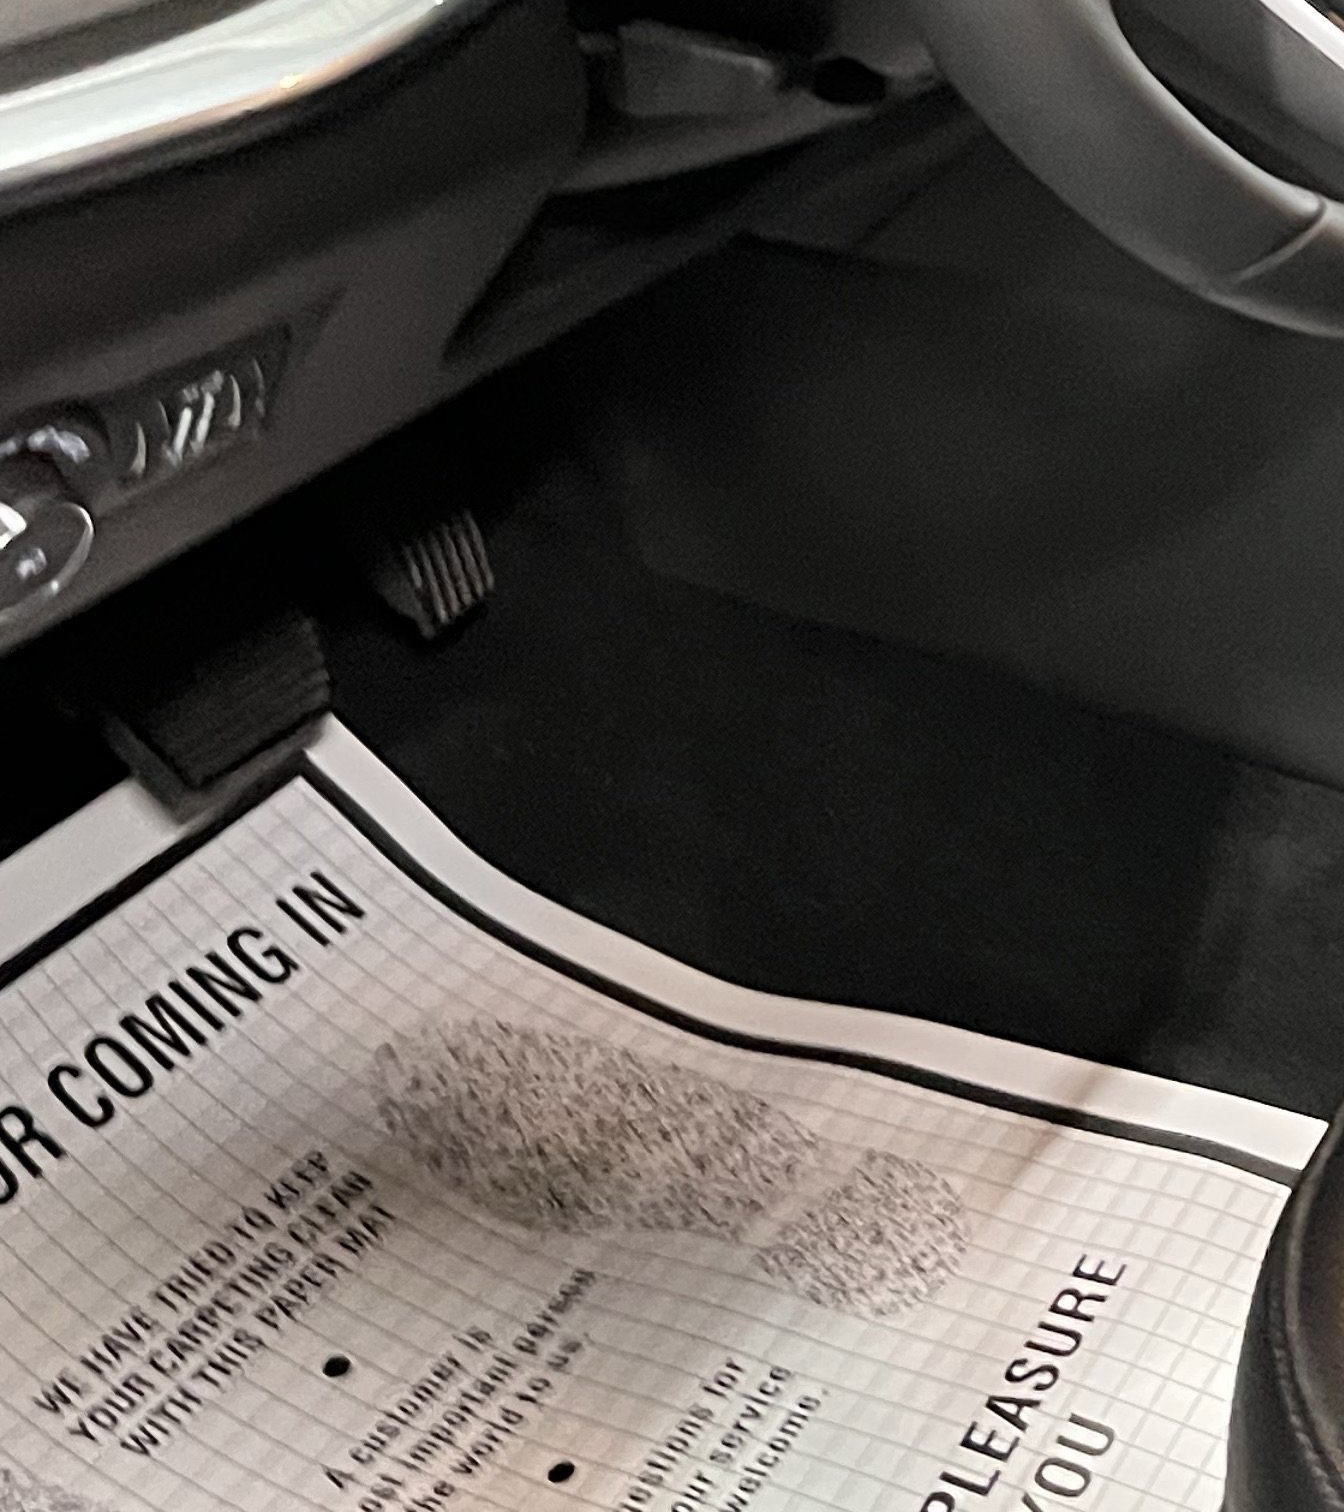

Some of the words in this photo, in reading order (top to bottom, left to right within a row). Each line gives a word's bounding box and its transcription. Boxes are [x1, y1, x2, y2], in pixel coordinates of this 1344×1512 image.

[47, 926, 300, 1128] COMING
[276, 871, 366, 947] IN
[33, 1368, 84, 1414] WE
[80, 1305, 158, 1376] HAVE
[150, 1240, 236, 1313] TRIED
[228, 1206, 276, 1240] TO
[263, 1149, 329, 1210] KEEP
[68, 1373, 155, 1443] YOUR
[149, 1241, 296, 1377] CARPETING
[286, 1170, 374, 1249] CLEAN
[120, 1387, 204, 1457] WITH
[191, 1327, 268, 1389] THIS
[255, 1252, 353, 1332] PAPER
[338, 1202, 397, 1257] MAT
[396, 1352, 519, 1472] important
[511, 1267, 598, 1356] person
[701, 1355, 745, 1400] for
[349, 1350, 463, 1465] customer
[451, 1406, 525, 1476] world
[708, 1365, 793, 1464] service
